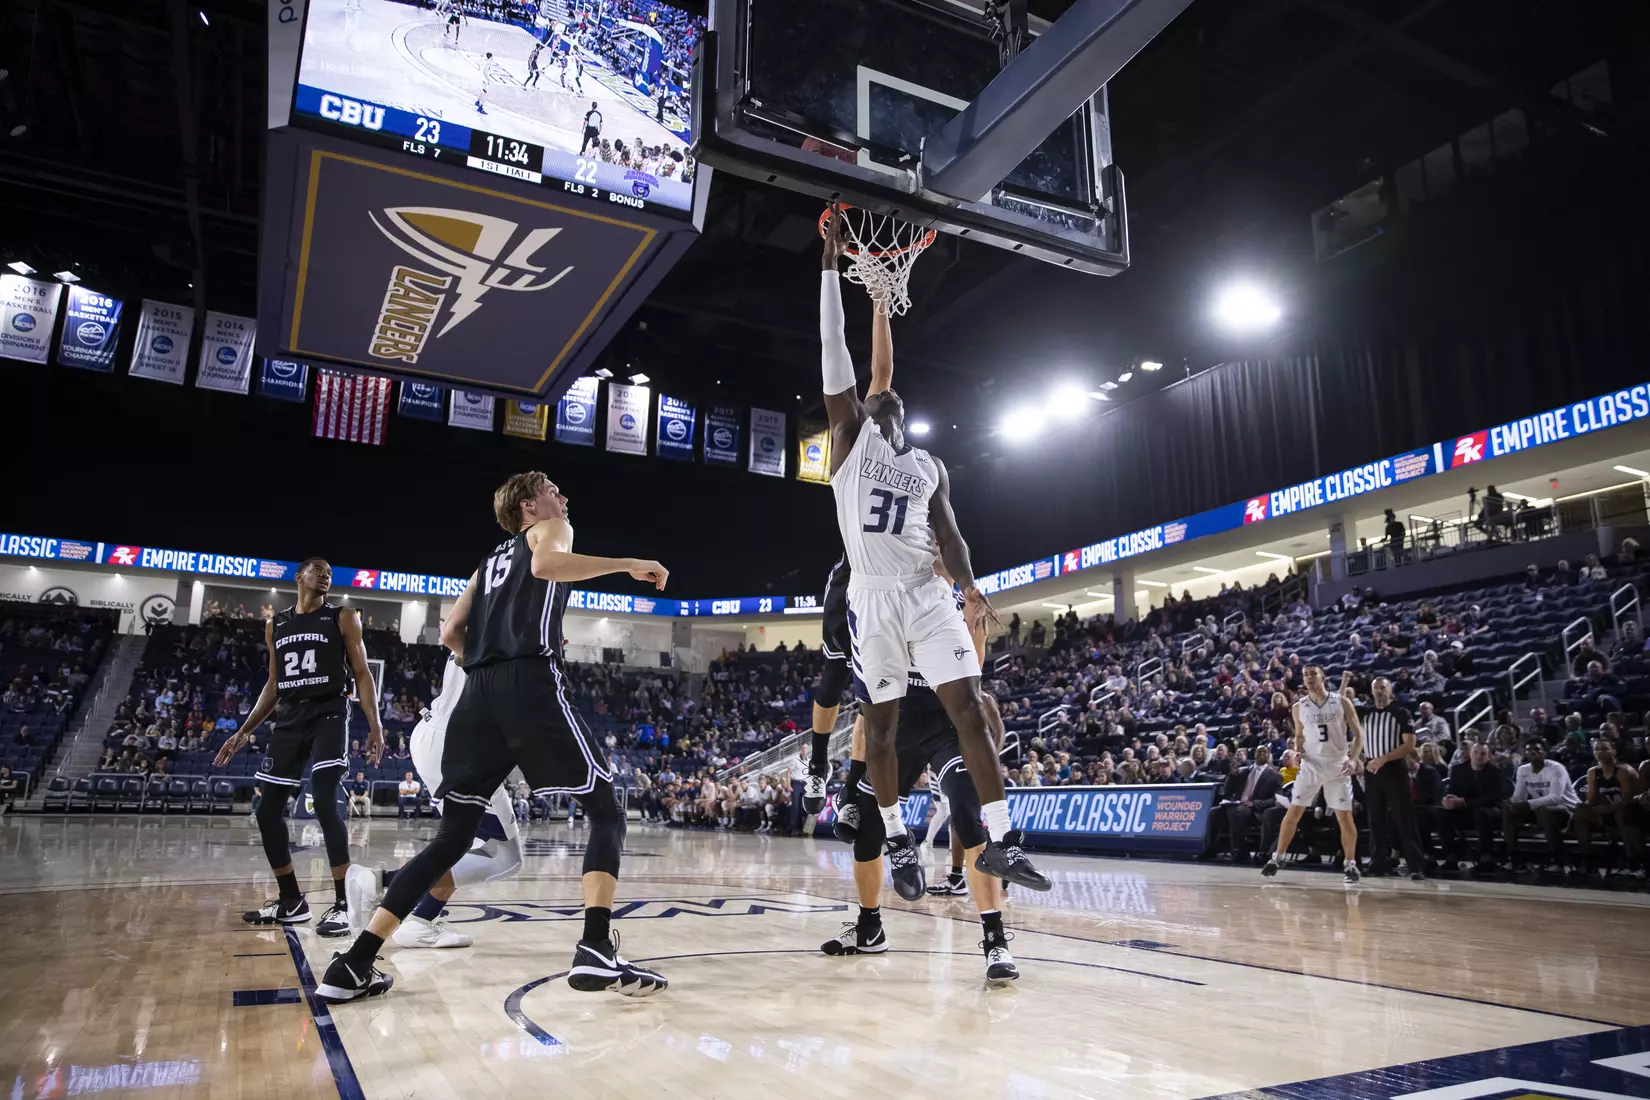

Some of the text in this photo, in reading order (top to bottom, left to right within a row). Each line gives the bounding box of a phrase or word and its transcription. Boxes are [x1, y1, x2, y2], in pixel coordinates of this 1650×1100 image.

[319, 93, 386, 131] CBU
[414, 117, 441, 144] 23
[403, 141, 441, 158] FLS 7
[487, 135, 529, 165] 11:34
[574, 158, 598, 183] 22
[564, 181, 645, 208] FLS 2 BONUS
[14, 284, 46, 297] 2016
[79, 295, 113, 308] 2016
[215, 319, 245, 331] 2014
[368, 265, 453, 364] LANCERS
[556, 424, 593, 434] CHAMPIONS
[1490, 407, 1570, 457] EMPIRE
[1572, 383, 1650, 434] CLASS
[860, 458, 928, 498] LANCERS
[1270, 479, 1324, 517] EMPIRE
[1325, 460, 1392, 502] CLASSIC
[863, 488, 909, 535] 31
[0, 534, 57, 558] LASSIC
[1081, 539, 1118, 569] EMPIRE
[1118, 526, 1163, 558] CLASSIC
[141, 548, 197, 571] EMPIRE
[198, 553, 257, 577] CLASSIC
[485, 547, 515, 596] 15
[379, 571, 426, 593] EMPIRE
[428, 576, 469, 597] CLASS
[1000, 563, 1035, 590] CLASSIC
[90, 600, 135, 609] BIBLICALLY
[586, 592, 632, 613] CLASSIC
[712, 600, 741, 614] CBU
[759, 598, 772, 612] 23
[284, 649, 317, 677] 24
[1318, 724, 1329, 742] 3
[1065, 792, 1152, 833] CLASSIC
[1154, 811, 1196, 821] WARRIOR
[1157, 801, 1203, 811] WOUNDED
[1152, 821, 1192, 831] PROJECT
